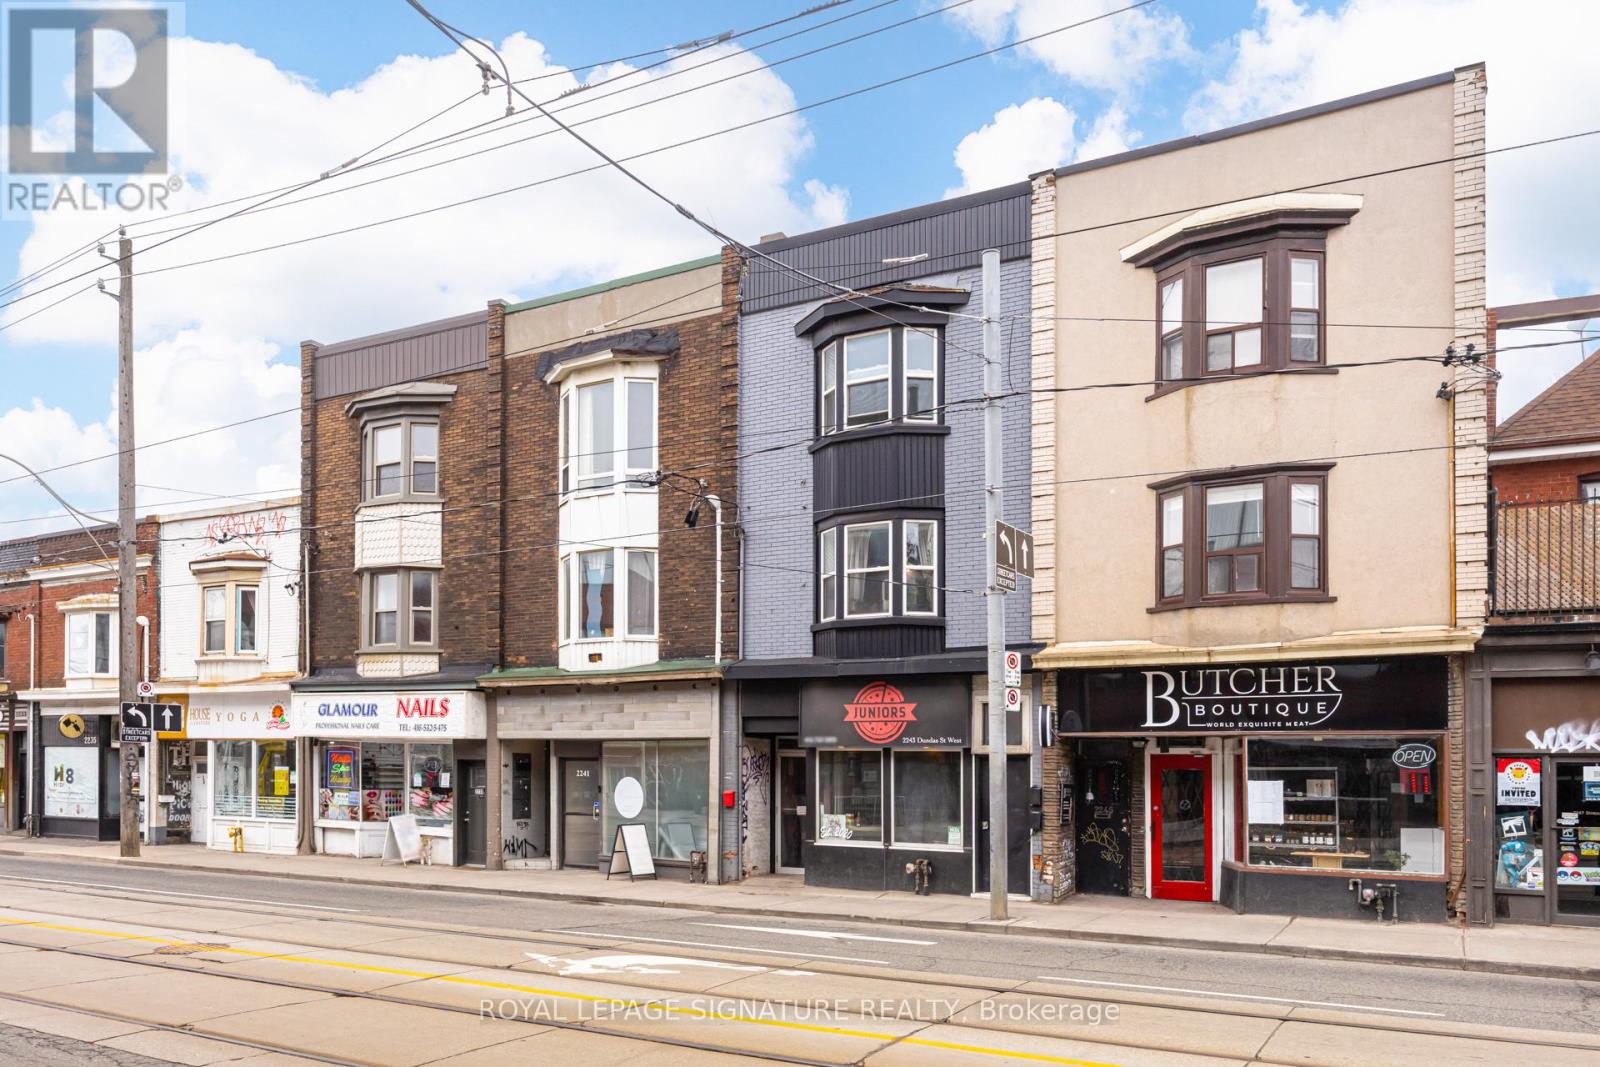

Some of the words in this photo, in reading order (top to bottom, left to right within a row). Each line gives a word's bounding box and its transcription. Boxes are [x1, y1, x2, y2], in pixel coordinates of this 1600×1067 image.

[1141, 666, 1342, 727] BUTCHER
[190, 707, 211, 720] HOUSE
[318, 703, 379, 717] GLAMOUR
[395, 697, 450, 718] NAILS
[853, 706, 906, 718] JUNIORS
[1195, 702, 1328, 716] BOUTIQUE
[84, 736, 97, 744] 2235
[917, 736, 939, 744] Dundas
[940, 736, 946, 744] St
[947, 736, 962, 744] West
[1395, 750, 1432, 762] OPEN
[576, 769, 590, 777] 2241
